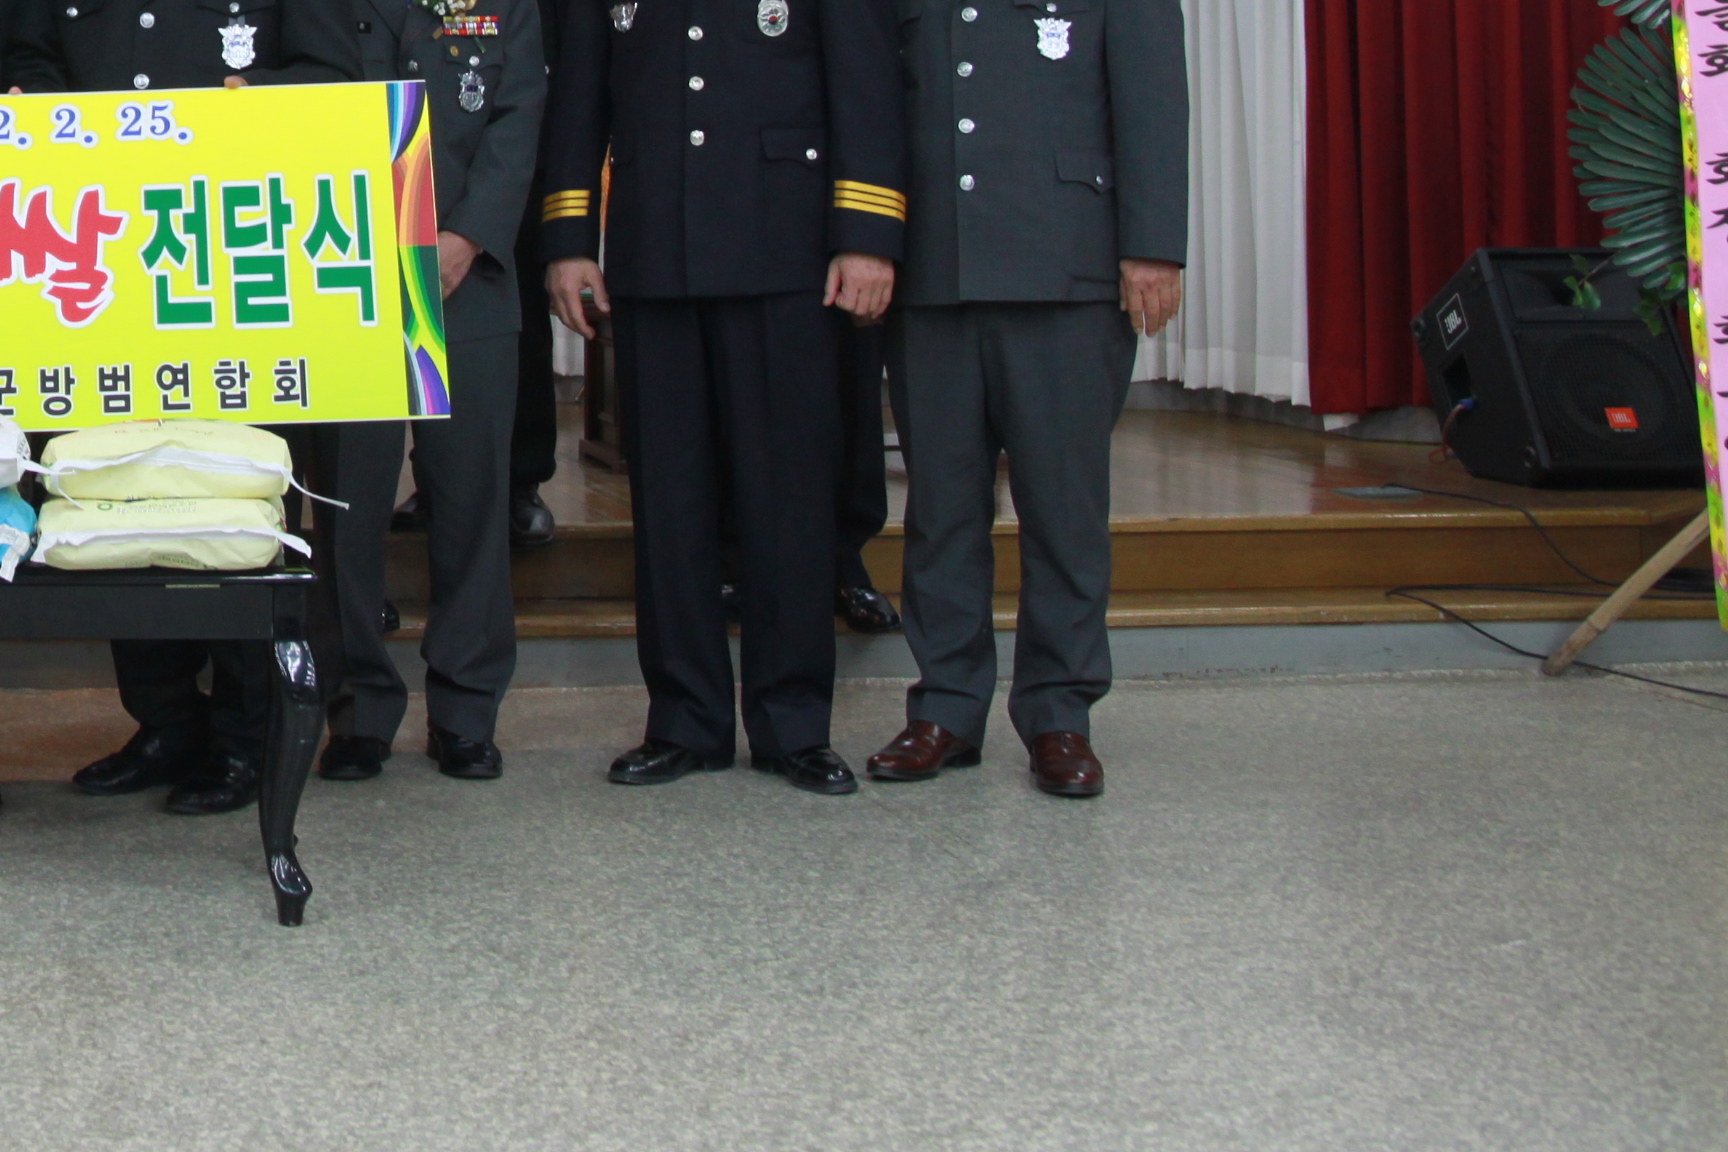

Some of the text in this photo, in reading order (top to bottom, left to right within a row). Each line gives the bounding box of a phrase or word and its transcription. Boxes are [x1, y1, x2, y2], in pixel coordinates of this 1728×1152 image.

[55, 106, 95, 144] 2.
[120, 104, 189, 141] 25.
[141, 173, 376, 325] 전달식
